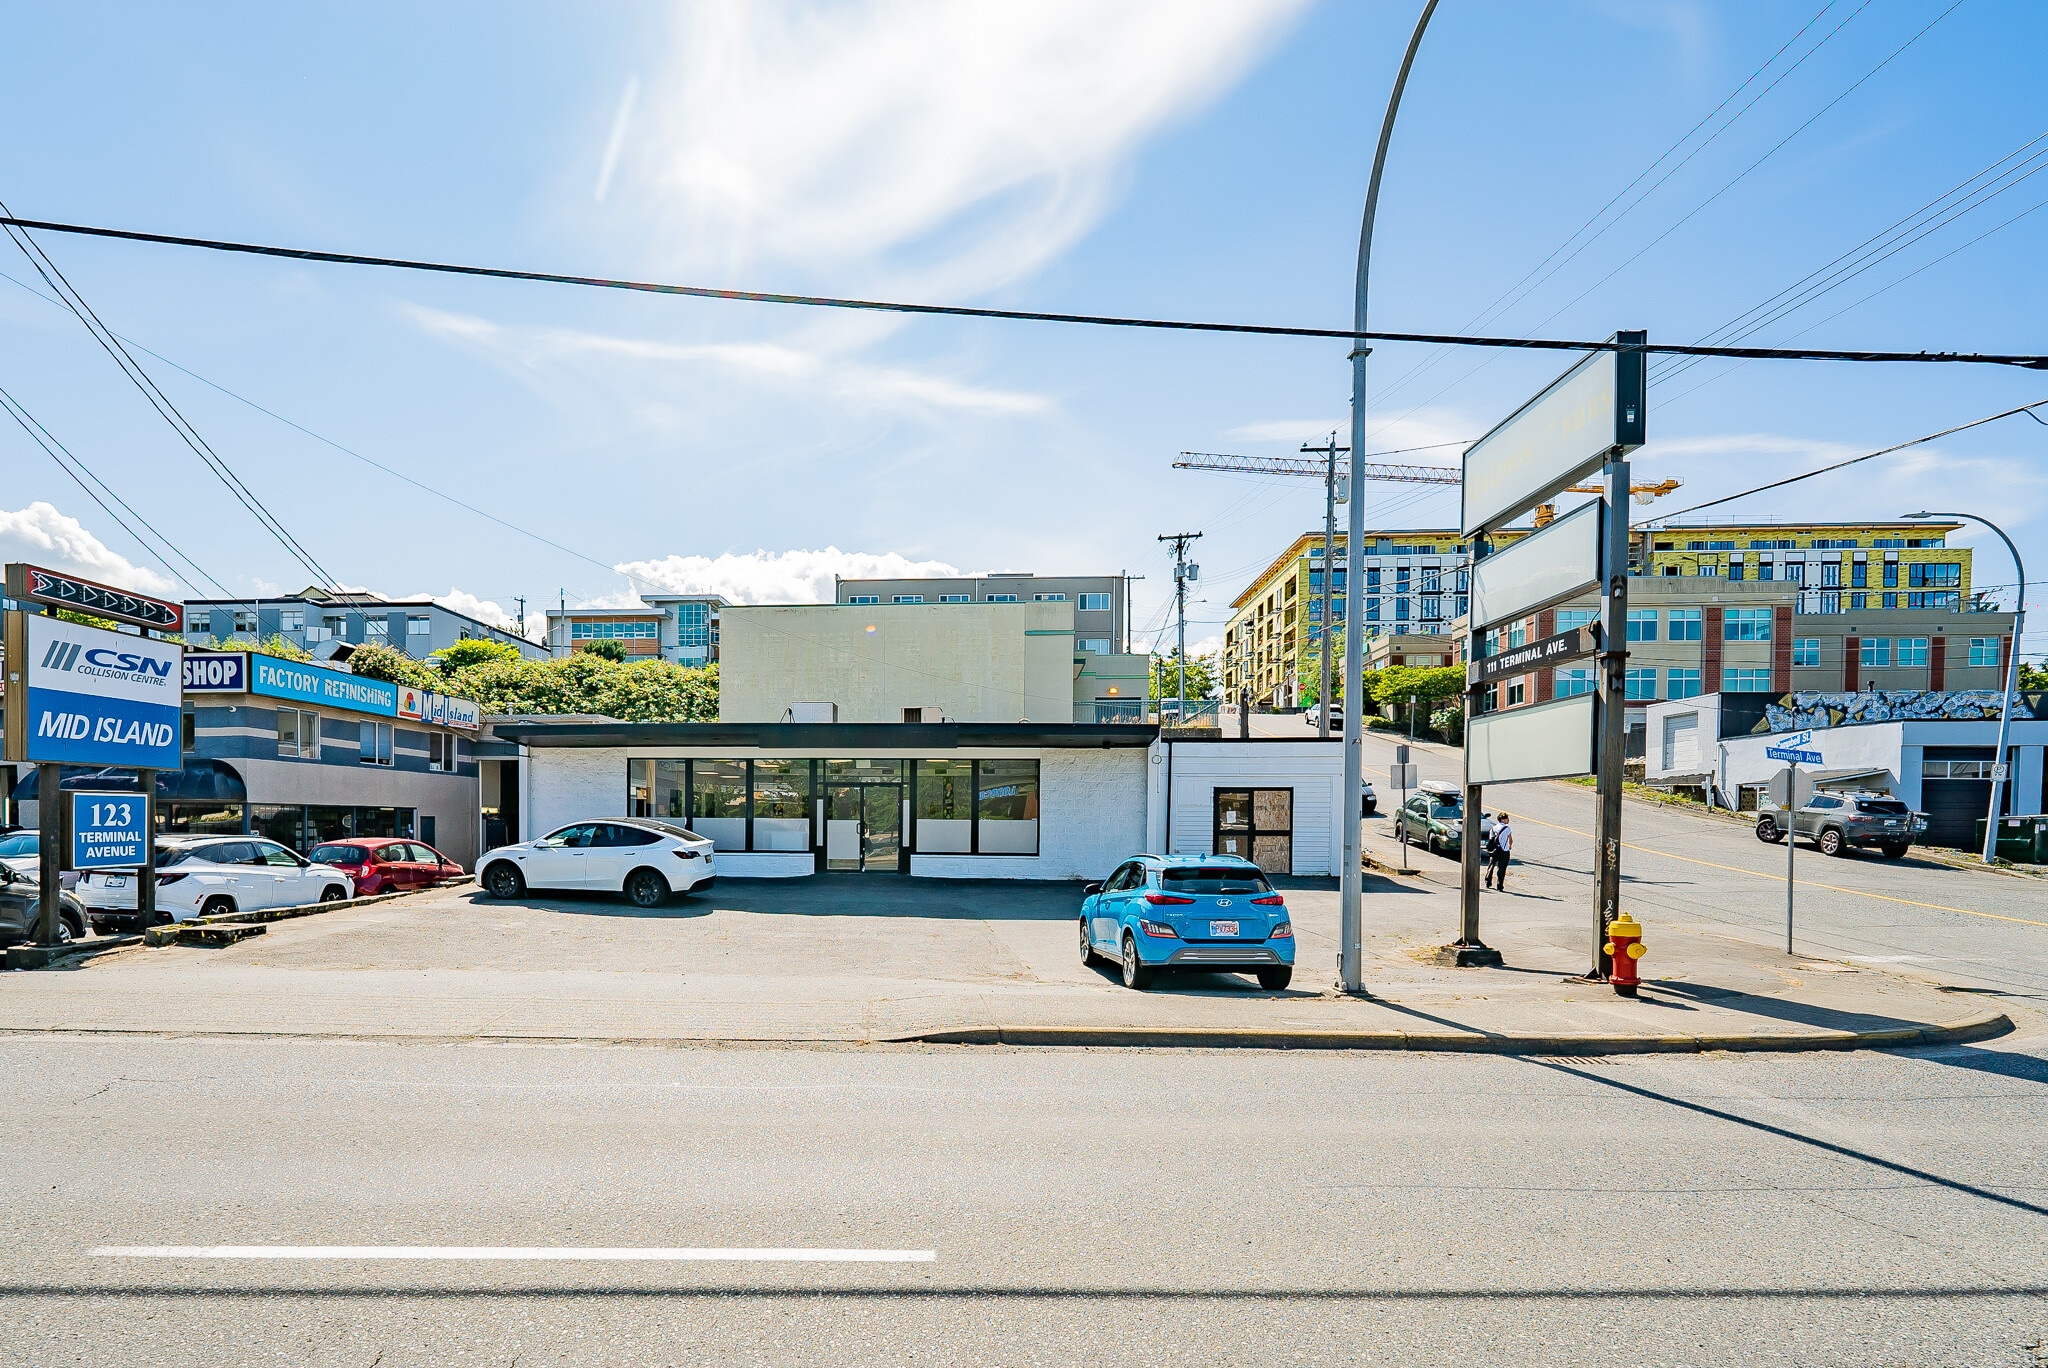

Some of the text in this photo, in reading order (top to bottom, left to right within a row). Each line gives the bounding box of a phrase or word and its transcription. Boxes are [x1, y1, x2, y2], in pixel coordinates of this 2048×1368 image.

[85, 648, 172, 677] CSN
[1487, 638, 1568, 673] 111 TERMINAL AVE.
[77, 665, 165, 686] COLLISION CENTRE
[183, 660, 238, 686] SHOP
[259, 665, 392, 707] FACTORY REFINISHING
[422, 693, 443, 720] Mid
[444, 697, 474, 723] Island
[38, 711, 174, 747] MID ISLAND
[1768, 747, 1821, 763] Terminal Ave
[91, 803, 131, 827] 123
[79, 831, 142, 844] TERMINAL
[86, 845, 136, 859] AVENUE
